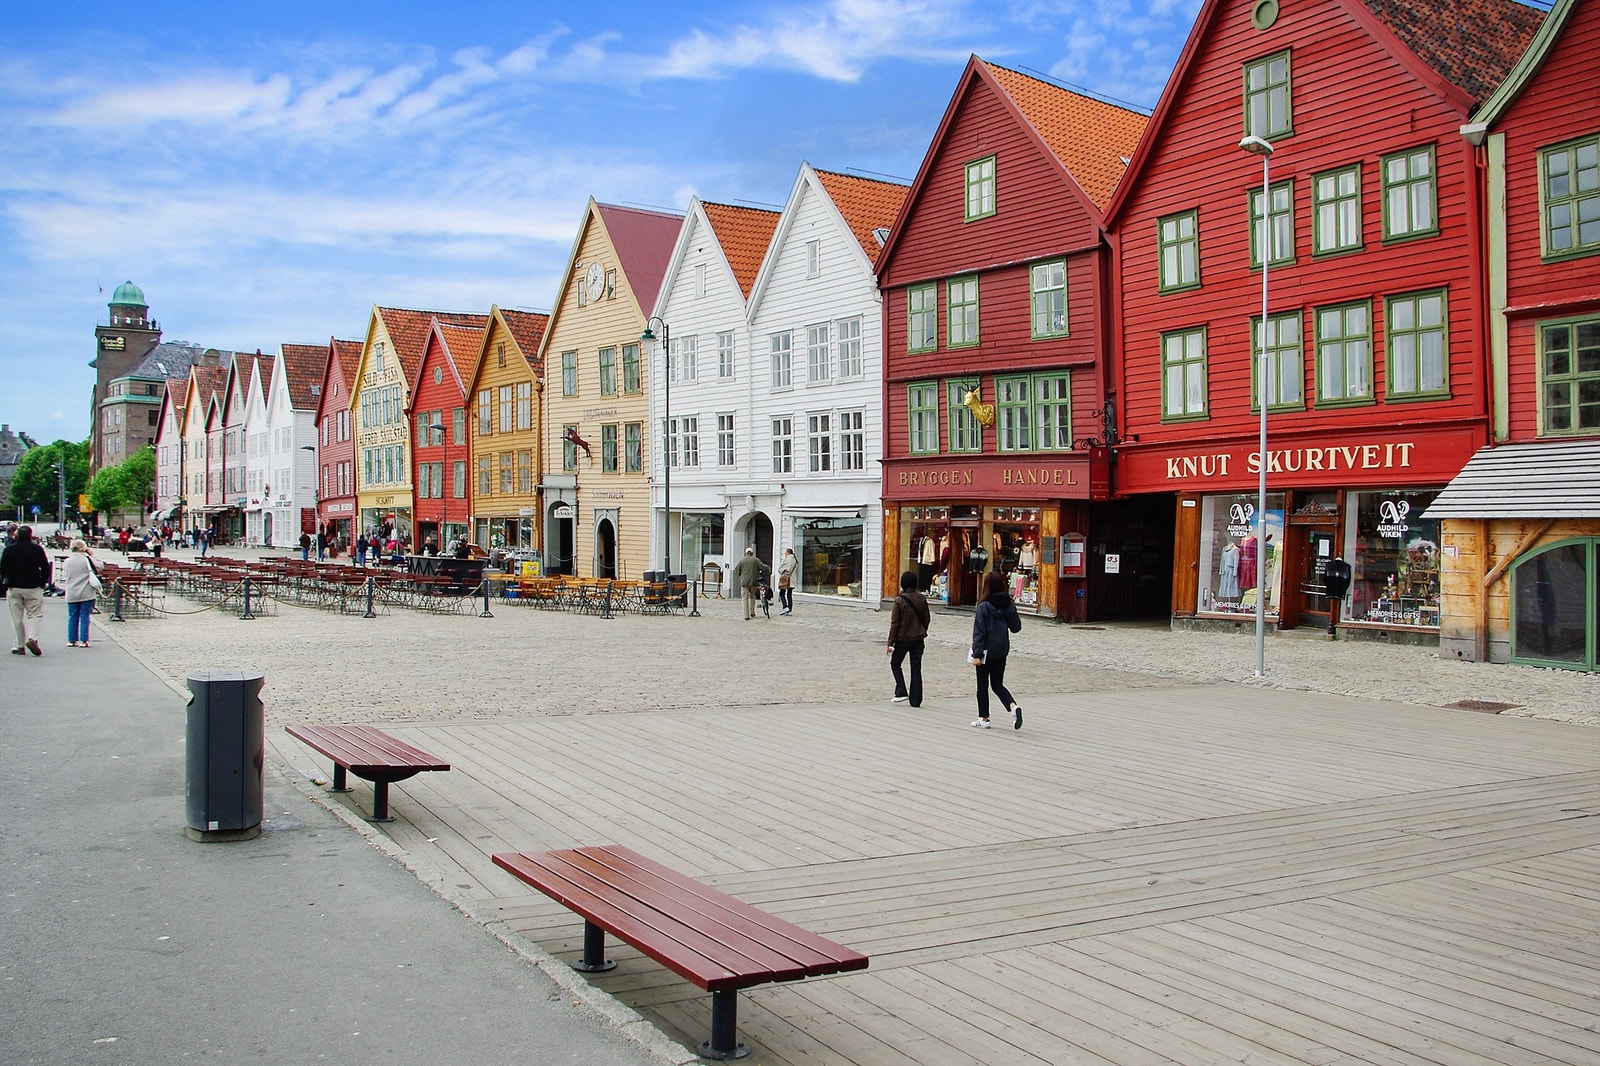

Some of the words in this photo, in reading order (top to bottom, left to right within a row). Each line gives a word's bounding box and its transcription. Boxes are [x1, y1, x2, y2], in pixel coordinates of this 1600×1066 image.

[1166, 454, 1231, 478] KNUT
[1247, 443, 1414, 473] SKURTVEIT
[899, 470, 973, 486] BRYGGEN
[1003, 469, 1078, 485] HANDEL
[1377, 524, 1409, 532] AUDHILD
[1367, 610, 1397, 618] MEMORIES
